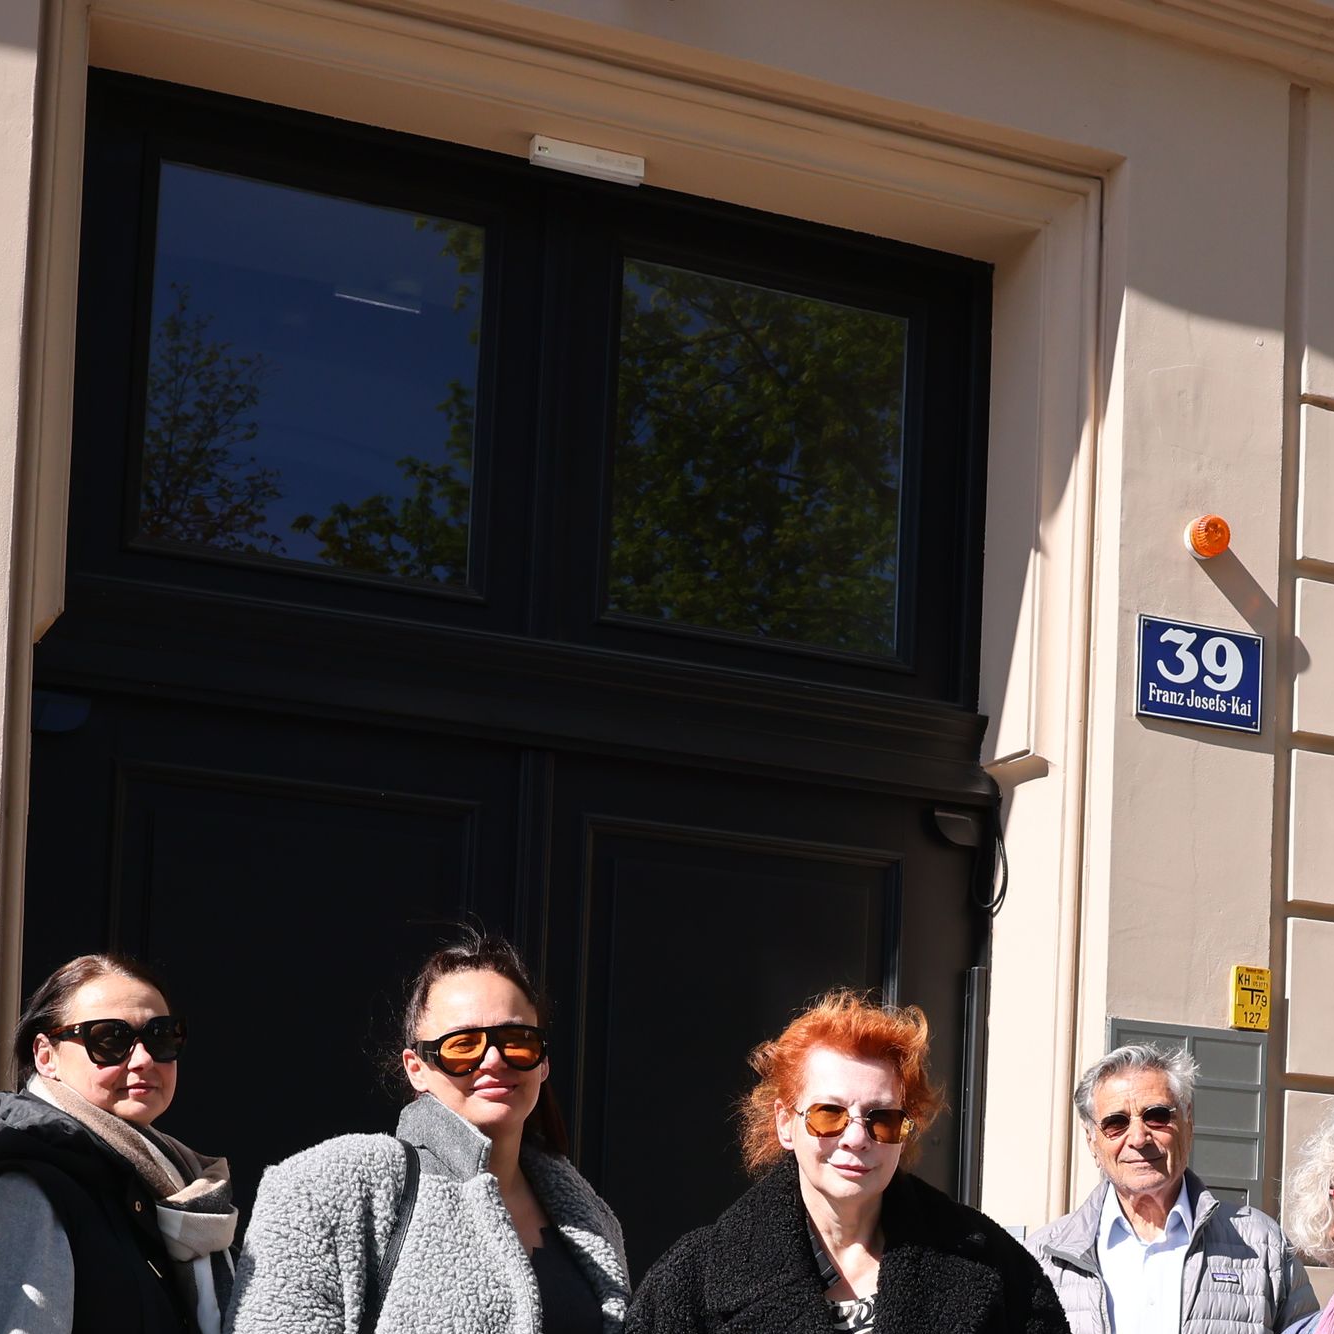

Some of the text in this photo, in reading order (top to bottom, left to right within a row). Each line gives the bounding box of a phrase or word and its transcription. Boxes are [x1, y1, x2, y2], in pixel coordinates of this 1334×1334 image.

[1156, 627, 1243, 692] 39
[1148, 682, 1252, 717] Franz Josefs-Kai
[1238, 973, 1251, 986] KH
